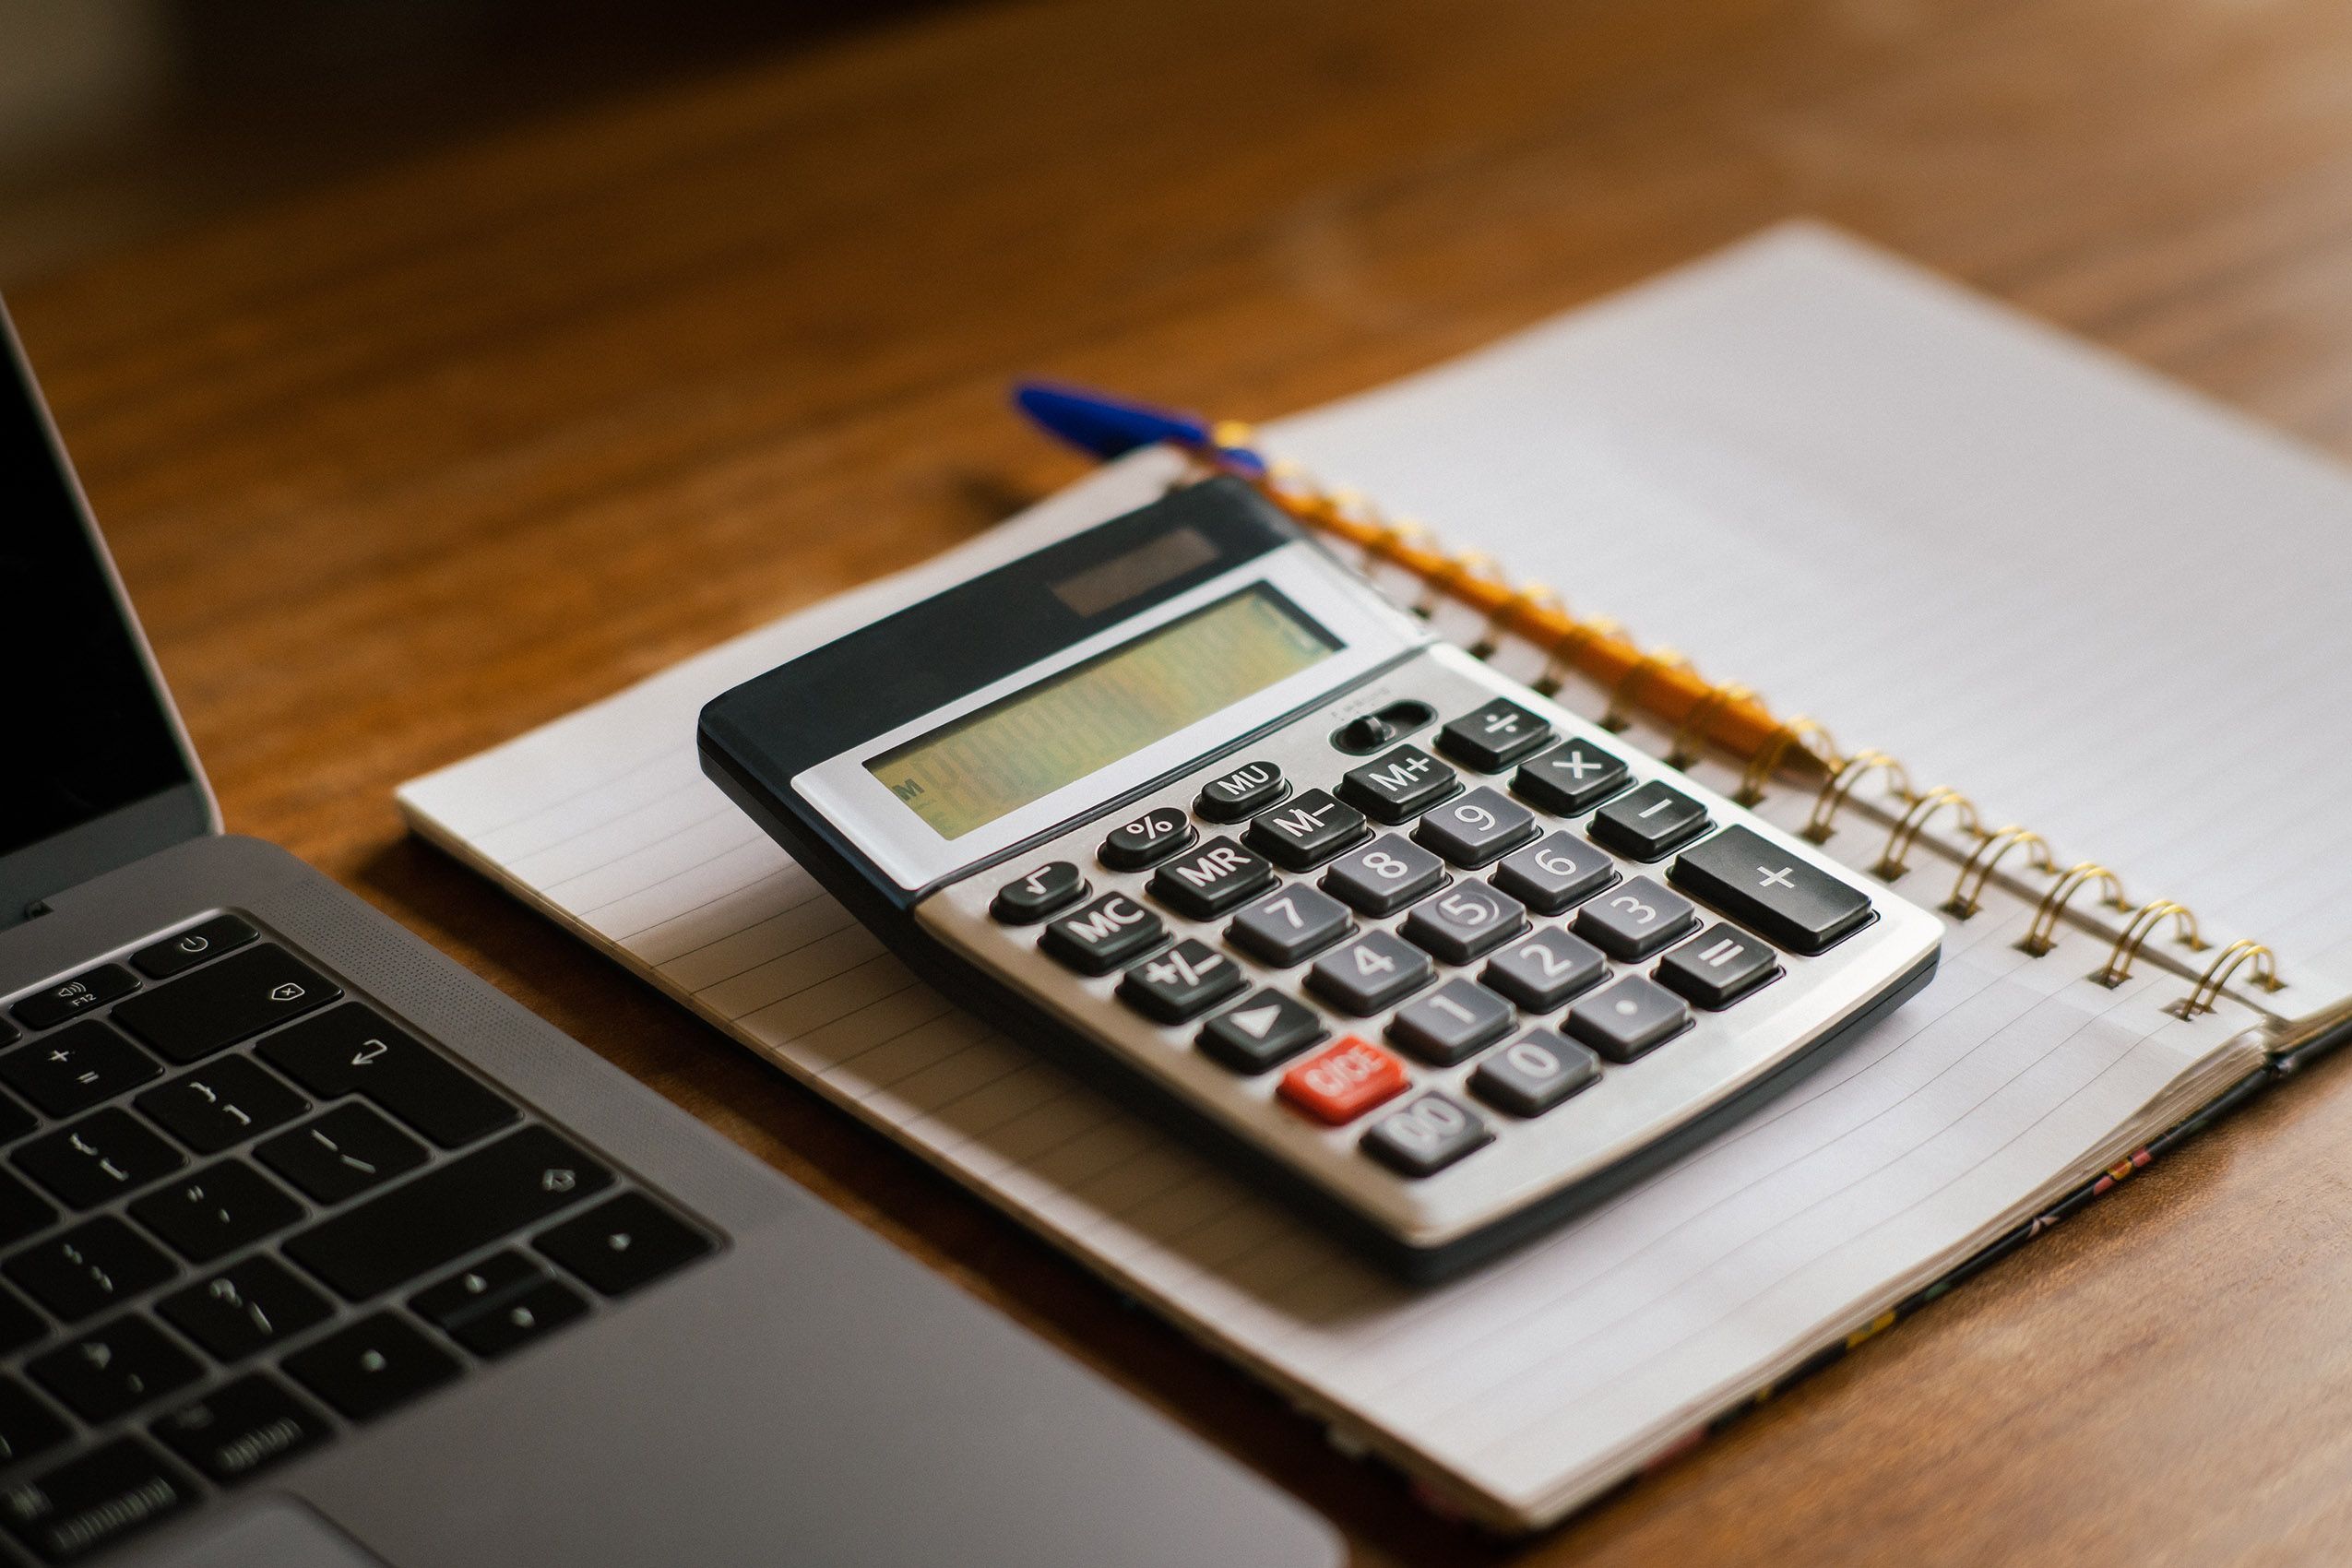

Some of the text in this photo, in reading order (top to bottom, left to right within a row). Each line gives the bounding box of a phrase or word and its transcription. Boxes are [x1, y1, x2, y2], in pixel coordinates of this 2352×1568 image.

[892, 778, 925, 802] M
[1215, 764, 1271, 797] MU
[1368, 755, 1431, 792] M+
[1125, 808, 1174, 840] %
[1454, 803, 1497, 833] 9
[1176, 845, 1253, 889] MR
[1361, 851, 1409, 879] 8
[1534, 848, 1577, 876] 6
[1066, 897, 1146, 944] MC
[1264, 898, 1305, 929] 7
[1450, 893, 1489, 926] 5
[1610, 896, 1657, 925] 3
[1352, 944, 1396, 977] 4
[1519, 942, 1573, 979] 2
[72, 993, 97, 1007] F12
[1427, 992, 1477, 1025] 1
[1506, 1041, 1562, 1079] 0
[1388, 1098, 1465, 1149] 00
